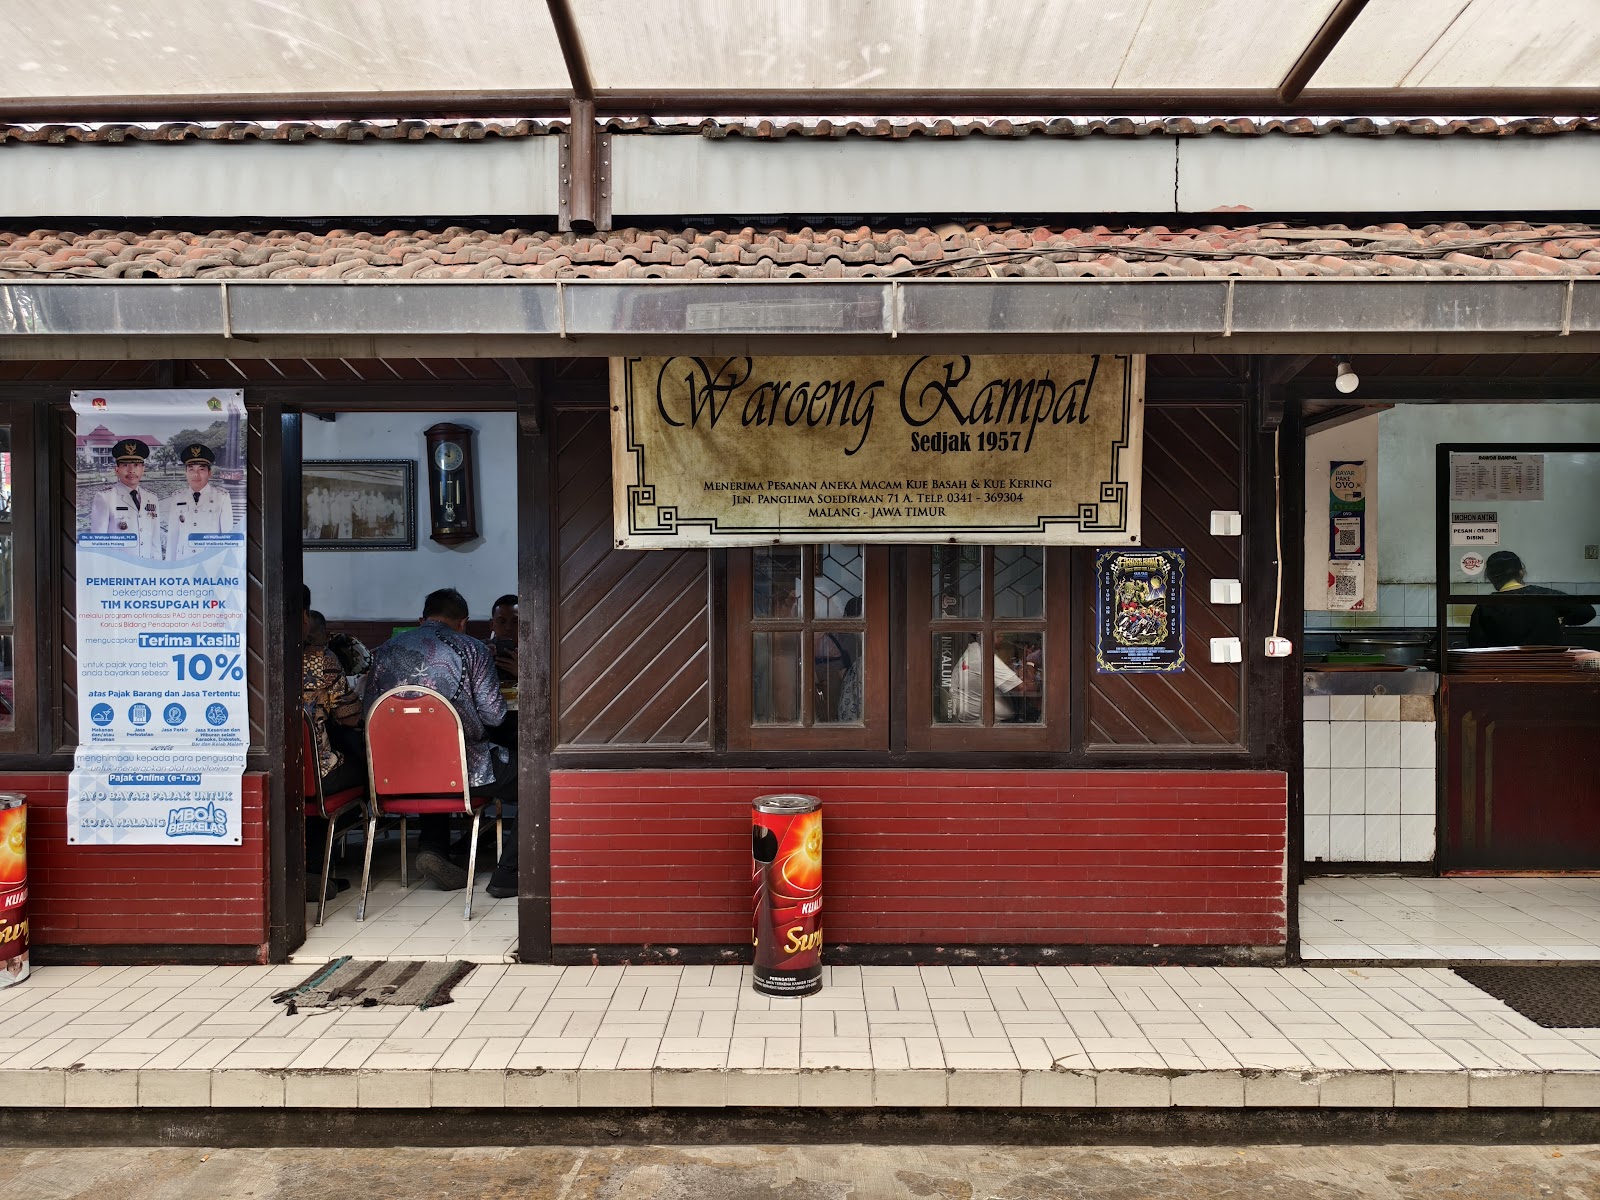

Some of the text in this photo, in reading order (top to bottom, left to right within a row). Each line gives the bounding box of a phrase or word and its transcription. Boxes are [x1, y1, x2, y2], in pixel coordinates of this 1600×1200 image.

[656, 355, 1100, 456] Waroeng Rampal
[911, 431, 1022, 454] Sedjak 1957
[703, 479, 1052, 491] MENERIMA PESANAN ANEKA MACAM KUE BASAH & KUE KERING
[1335, 481, 1355, 489] OVO
[732, 494, 754, 506] JLN.
[758, 494, 814, 504] PANGLIMA
[817, 494, 883, 504] SOEDIRMAN
[887, 493, 899, 503] 71
[903, 493, 913, 503] A.
[916, 493, 944, 503] TELP.
[947, 493, 973, 503] 0341
[984, 493, 1024, 503] 369304
[808, 507, 861, 517] MALANG
[871, 507, 902, 519] JAWA
[904, 507, 947, 517] TIMUR
[86, 577, 239, 586] PEMERINTAH KOTA MALANG
[112, 588, 215, 598] bekerjasama dengan
[101, 600, 226, 609] TIM KORSUPGAH KPK
[140, 634, 192, 647] Terima
[196, 634, 240, 647] Kasih!
[106, 662, 128, 670] pajak
[172, 653, 244, 681] 10%
[942, 636, 952, 688] INKALUM
[104, 670, 140, 678] bayarkan
[108, 690, 130, 698] Pajak
[132, 690, 162, 698] Barang
[76, 754, 134, 764] menghimbau
[136, 754, 171, 763] kepada
[195, 755, 244, 764] pengusaha
[109, 774, 200, 782] Pajak Online (e-Tax)
[80, 790, 233, 801] AYO BAYAR PAJAK UNTUK
[80, 818, 166, 828] KOTA MALANG
[166, 822, 228, 837] BERKELAS
